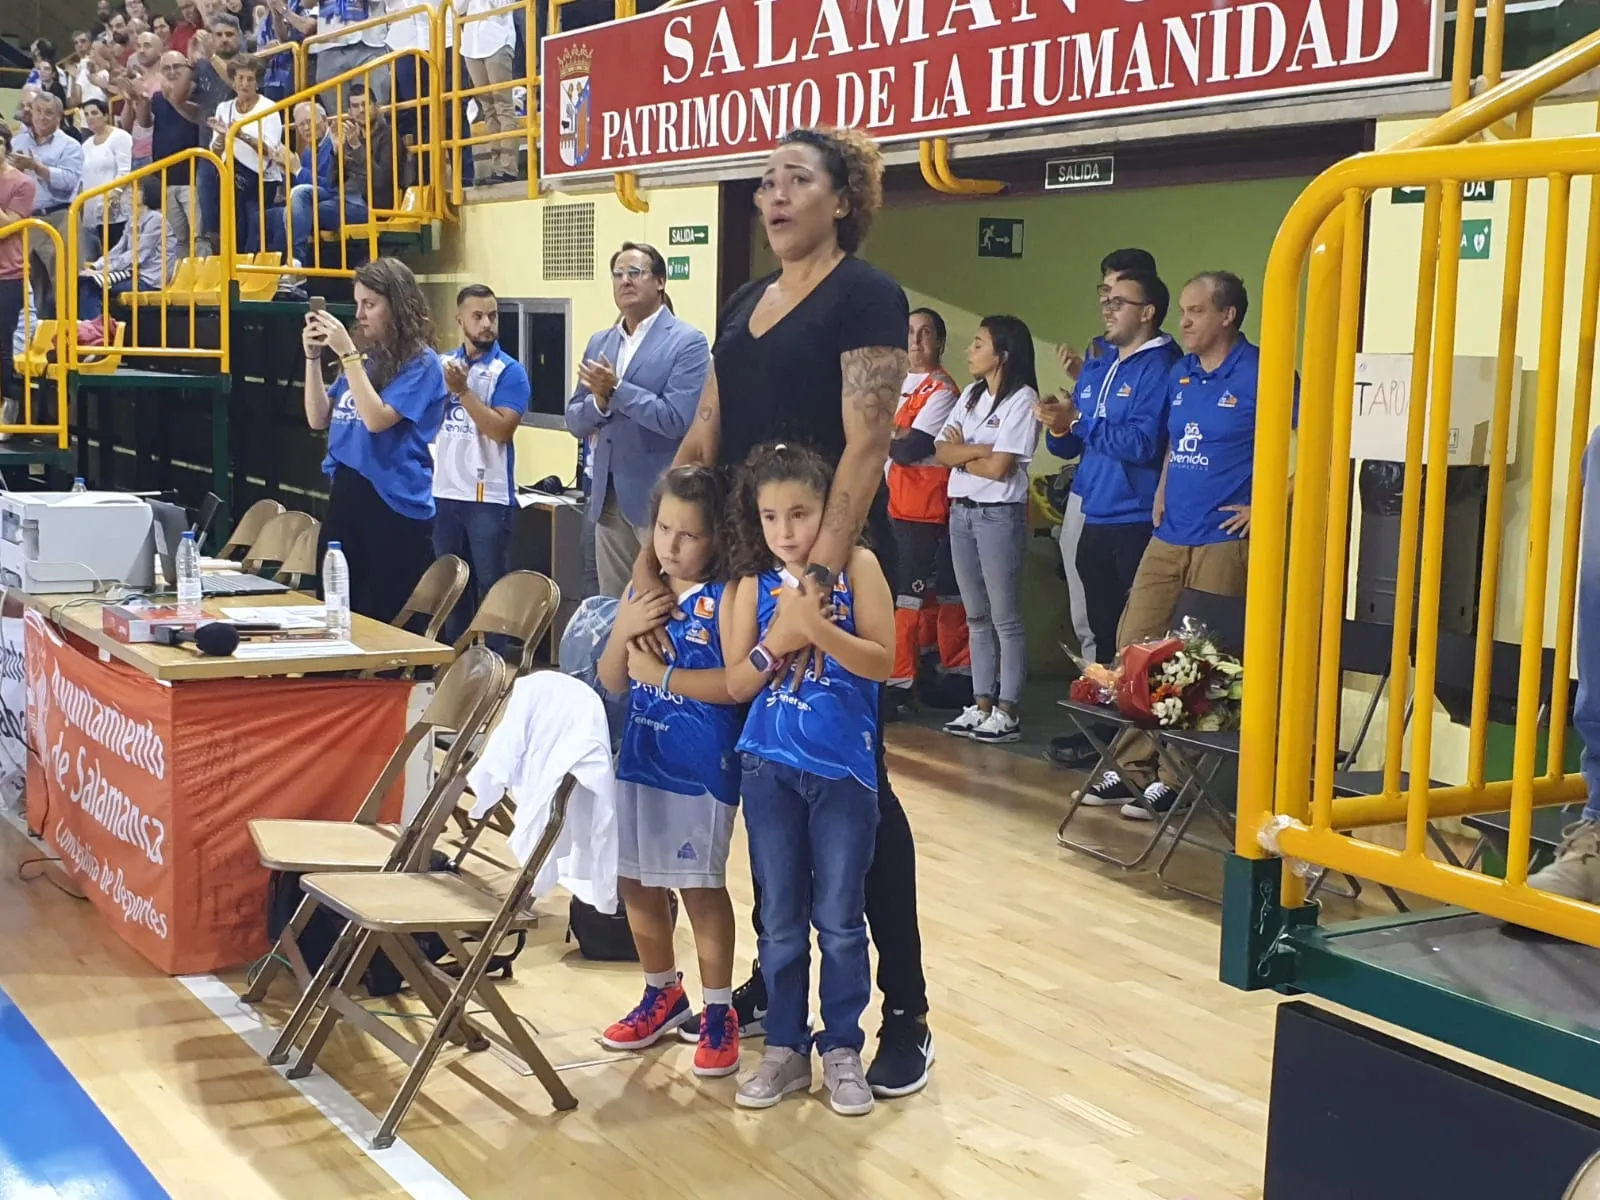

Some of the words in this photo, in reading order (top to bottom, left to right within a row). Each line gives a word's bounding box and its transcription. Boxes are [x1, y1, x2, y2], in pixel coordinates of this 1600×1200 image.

[601, 78, 821, 160] PATRIMONIO
[835, 66, 896, 130] DE
[911, 52, 970, 123] LA
[987, 0, 1399, 113] HUMANIDAD
[1058, 164, 1100, 182] SALIDA
[671, 228, 695, 243] SALIDA
[51, 655, 165, 780] Ayuntamiento
[51, 731, 71, 791] de
[70, 745, 164, 866] Salamanca
[99, 857, 114, 896] de
[112, 863, 168, 940] Deportes
